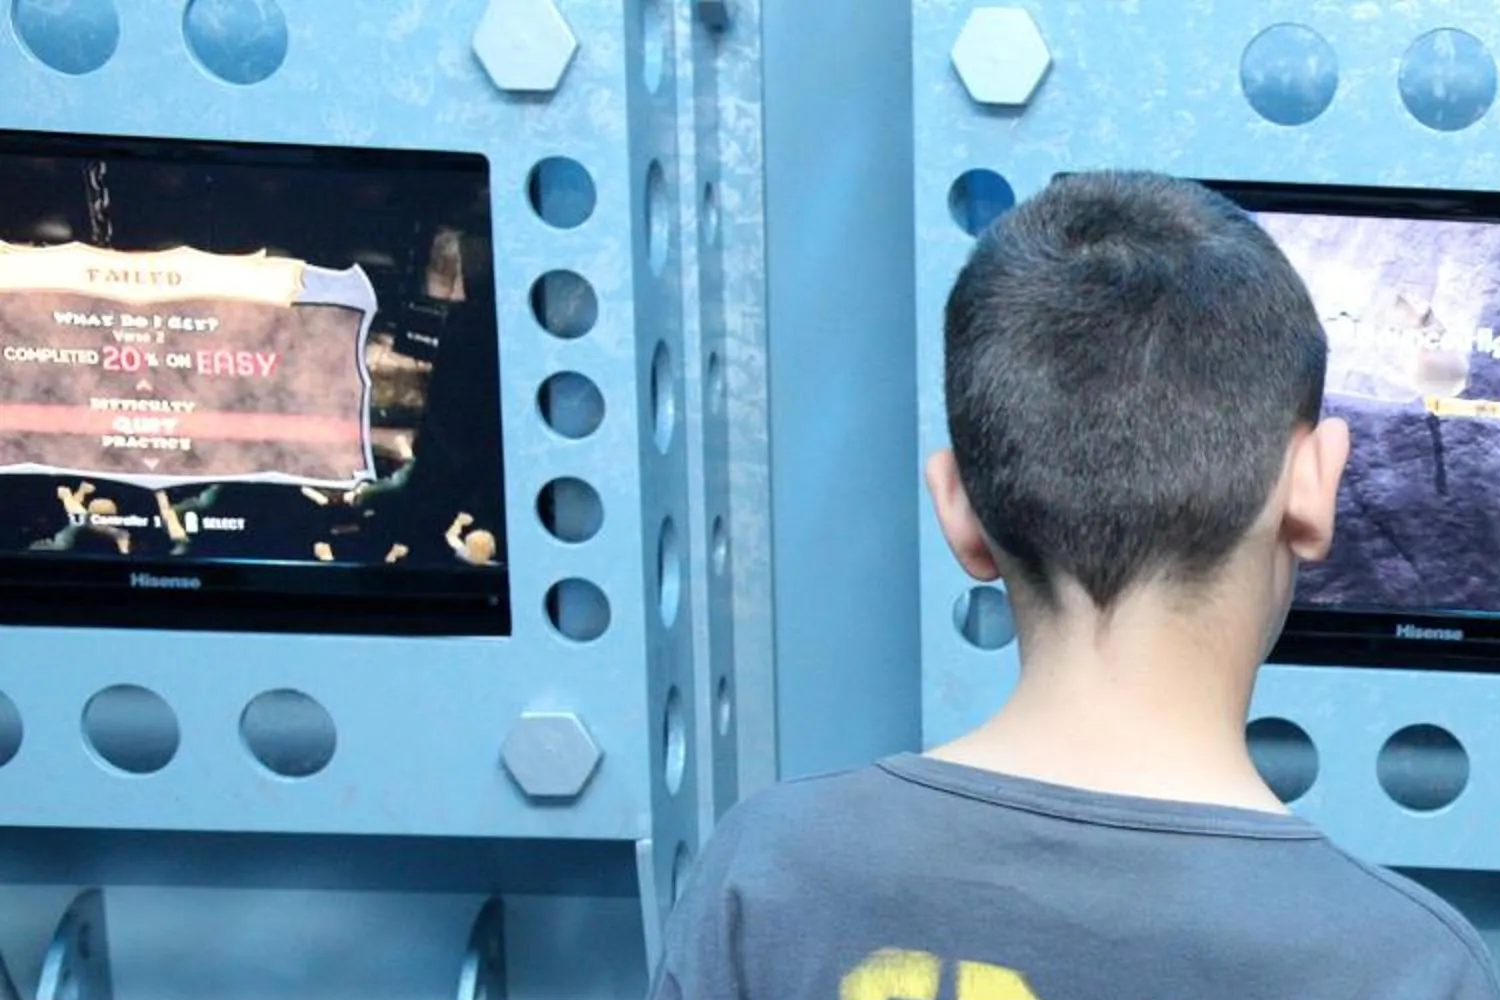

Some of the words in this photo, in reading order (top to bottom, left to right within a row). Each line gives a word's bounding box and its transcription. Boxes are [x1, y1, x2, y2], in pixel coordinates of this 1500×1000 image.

[120, 313, 148, 328] DO
[4, 346, 98, 366] COMPLETED
[166, 352, 191, 370] ON
[196, 351, 278, 378] EASY
[129, 571, 202, 590] Hisense
[1395, 623, 1464, 641] Hisense
